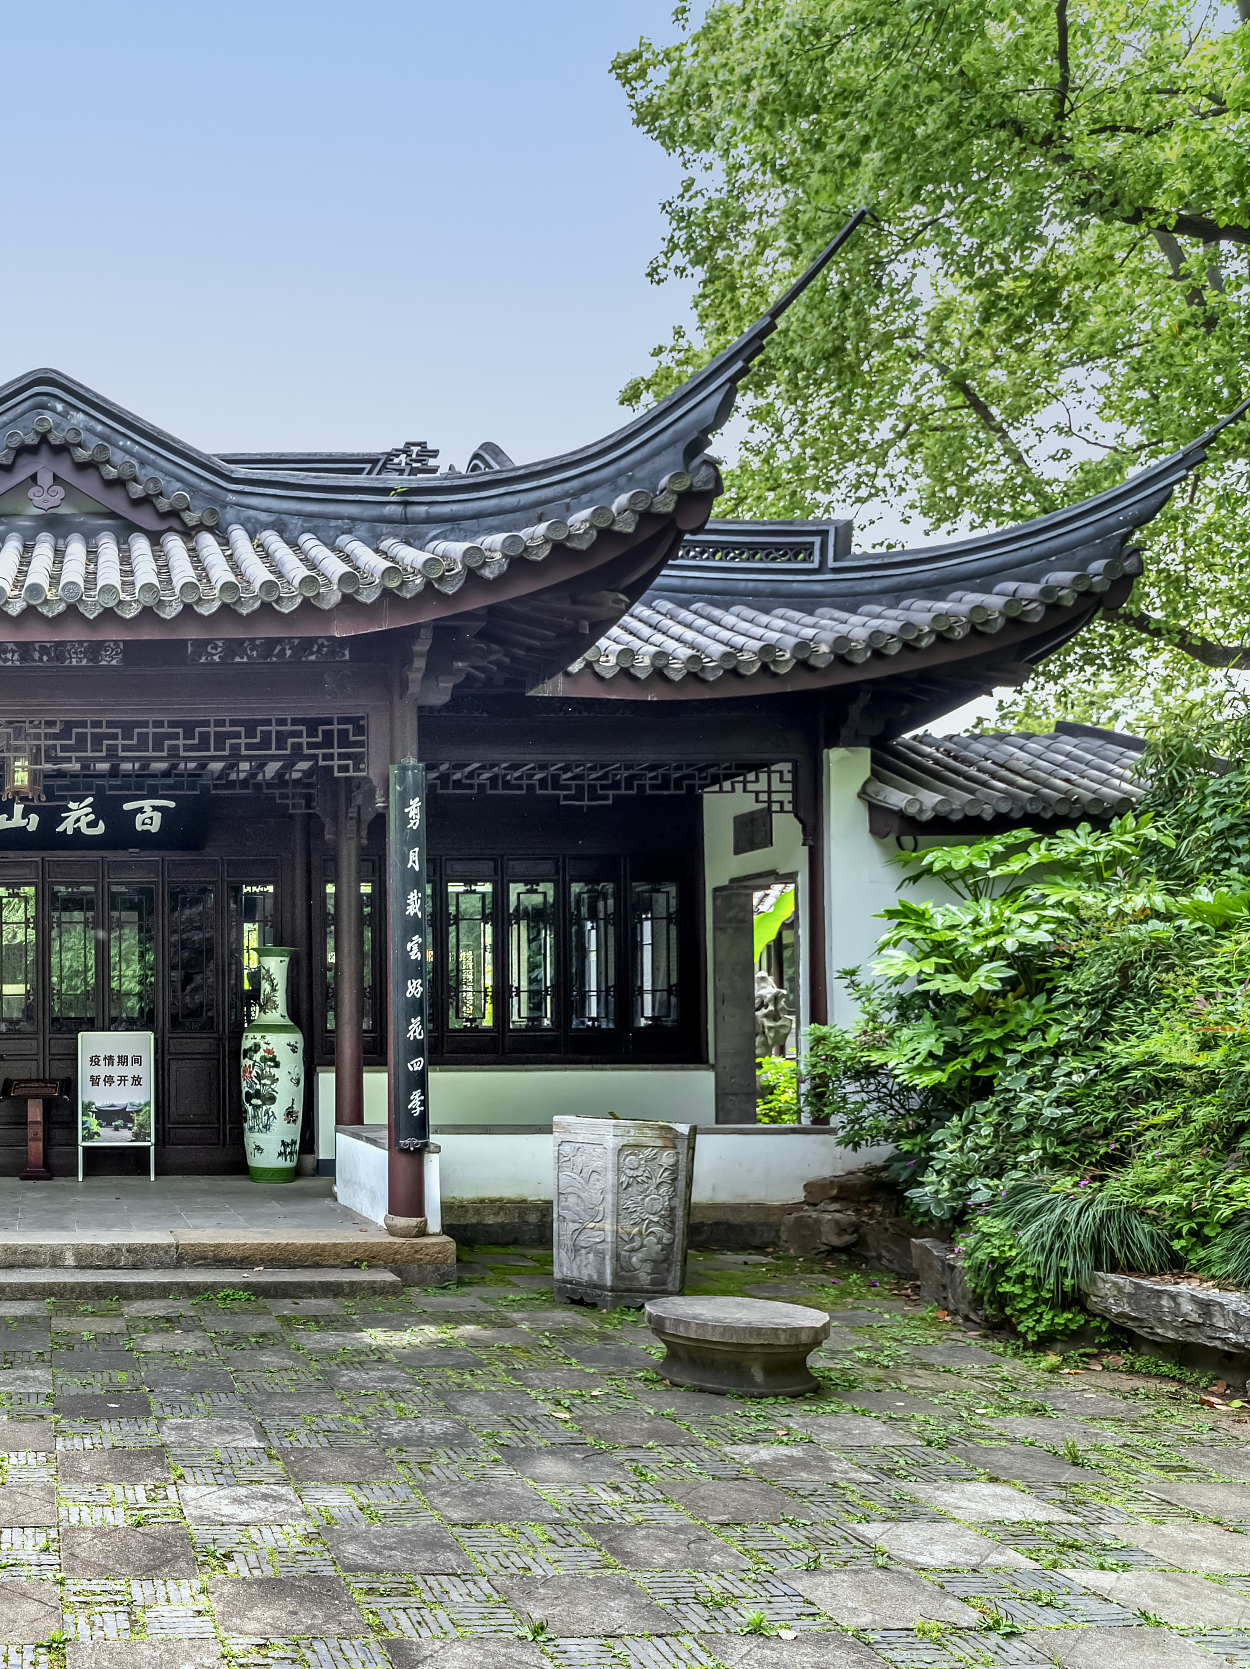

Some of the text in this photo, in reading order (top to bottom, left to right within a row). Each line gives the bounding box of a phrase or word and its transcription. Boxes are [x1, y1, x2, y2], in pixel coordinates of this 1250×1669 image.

[403, 797, 425, 1117] 剪月裁雲好花四季
[88, 1054, 143, 1067] 疫情期间
[88, 1074, 143, 1087] 暂停开放
